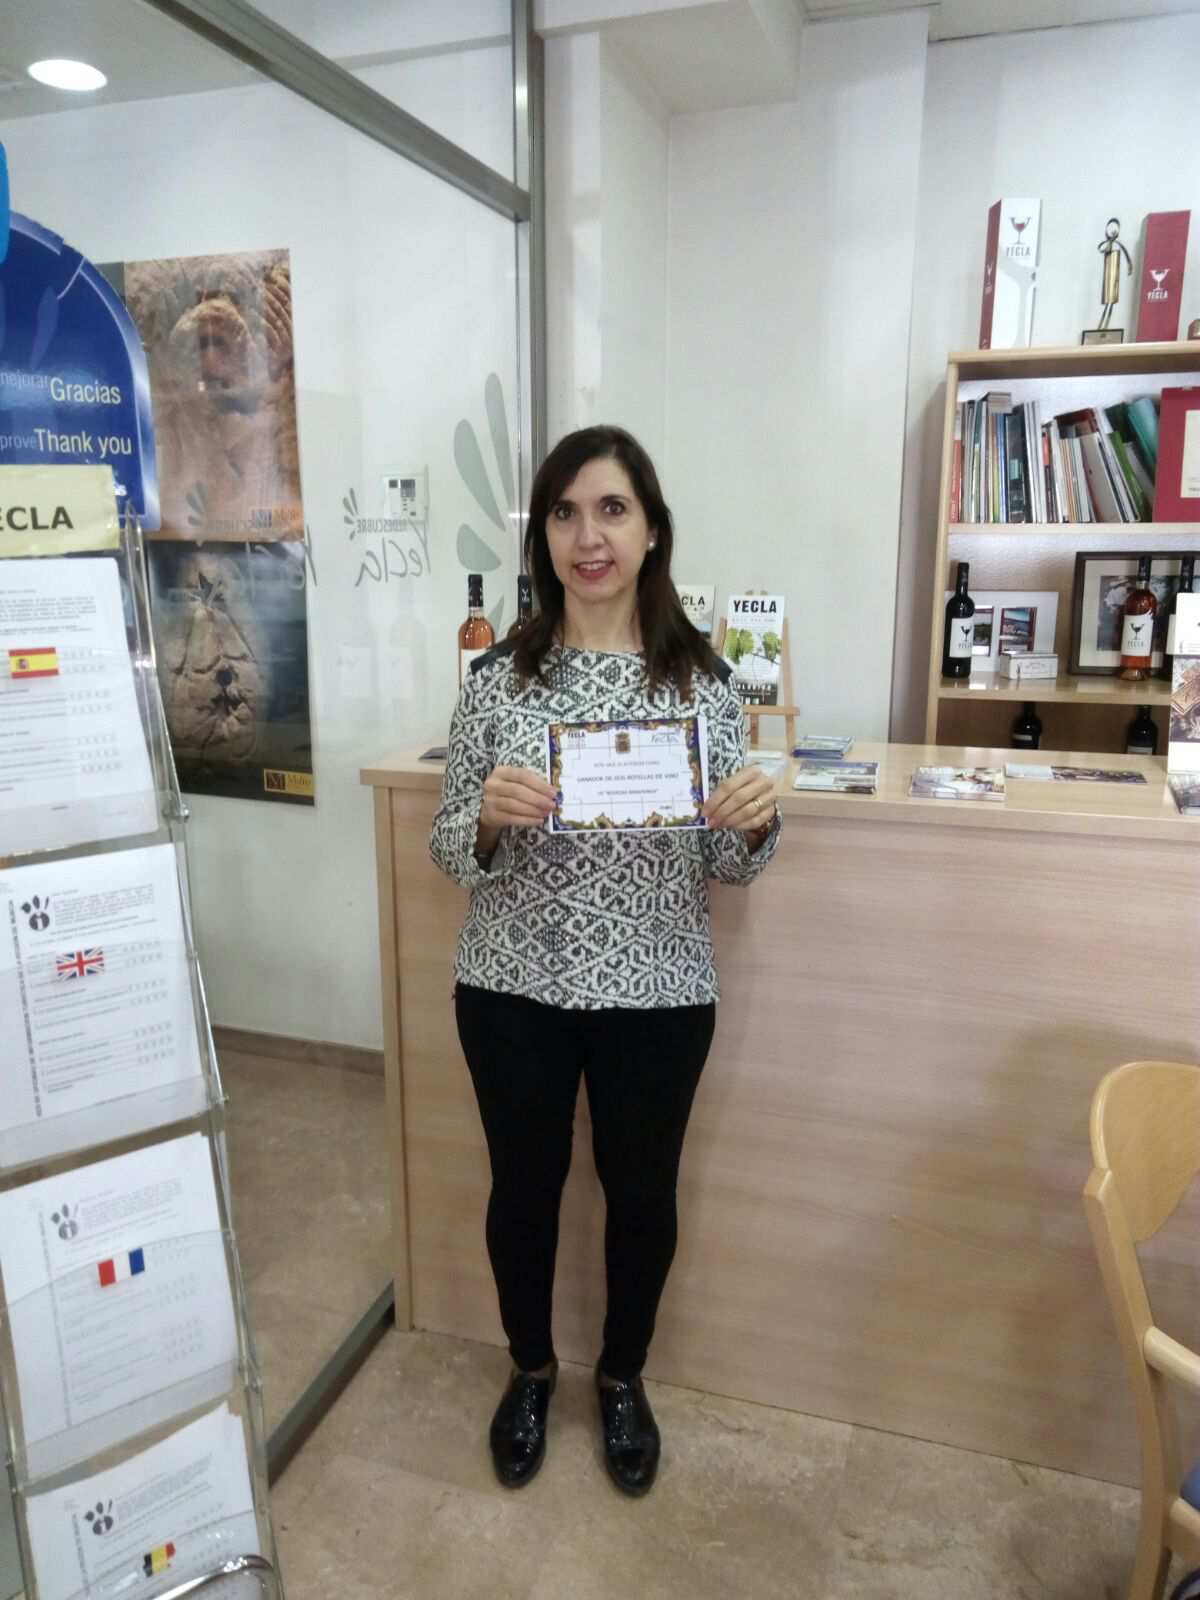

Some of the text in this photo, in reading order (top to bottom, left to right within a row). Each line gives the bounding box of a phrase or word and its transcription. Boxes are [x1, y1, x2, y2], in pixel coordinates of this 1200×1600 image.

[50, 377, 121, 405] Gracias
[33, 428, 94, 453] Thank
[97, 436, 132, 459] you
[0, 506, 74, 531] CLA
[733, 600, 777, 613] YECLA
